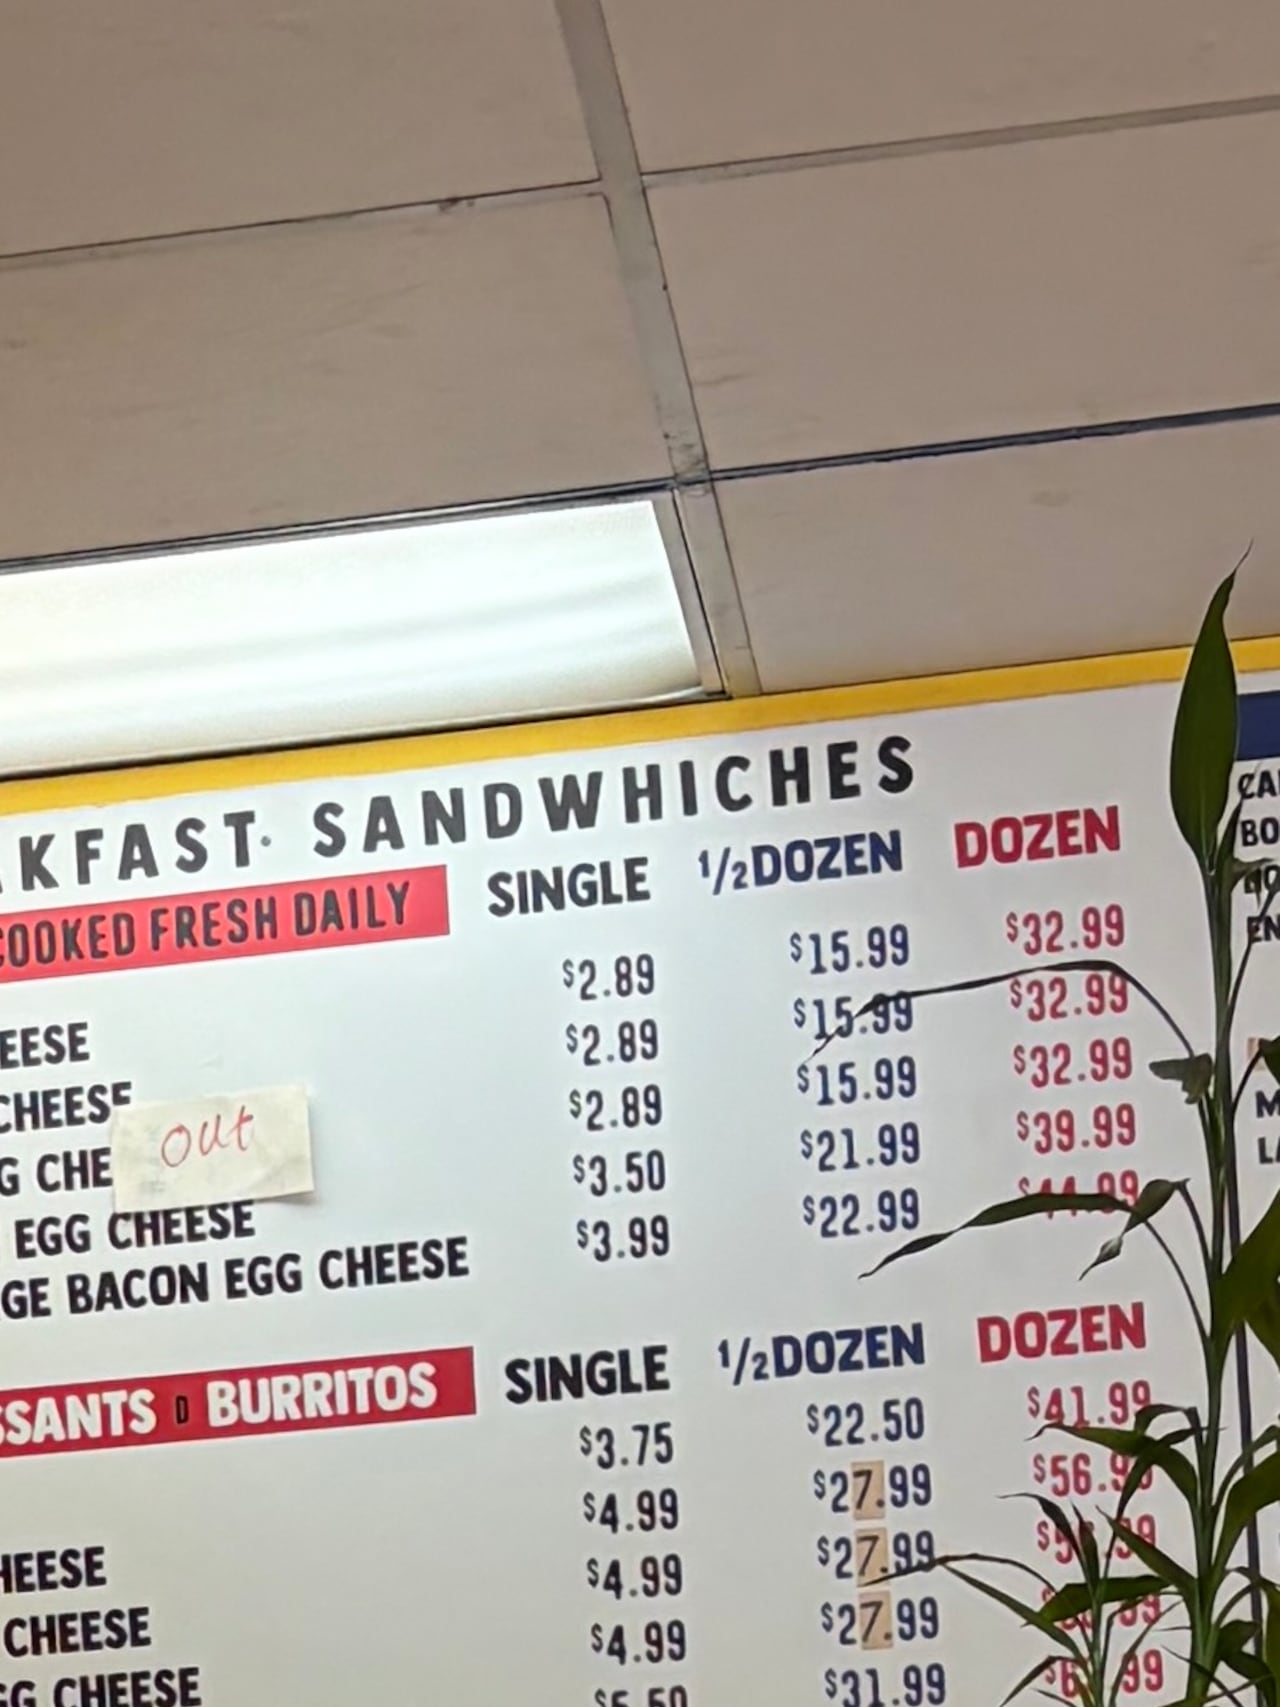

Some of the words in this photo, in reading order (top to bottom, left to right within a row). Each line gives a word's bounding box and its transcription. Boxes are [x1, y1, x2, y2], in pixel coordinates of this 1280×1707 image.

[314, 735, 913, 857] SANDWHICHES
[488, 857, 650, 917] SINGLE
[955, 805, 1120, 868] DOZEN
[150, 896, 278, 952] FRESH
[295, 881, 412, 937] DAILY
[563, 954, 654, 1000] $2.89
[790, 924, 909, 974] $15.99
[1006, 904, 1124, 955] $32.99
[566, 1019, 658, 1066] $2.89
[793, 993, 914, 1044] $15.99
[1009, 970, 1129, 1022] $32.99
[570, 1084, 662, 1131] $2.89
[797, 1056, 916, 1106] $15.99
[1014, 1037, 1132, 1088] $32.99
[573, 1149, 665, 1196] $3.50
[801, 1122, 920, 1172] $21.99
[1017, 1103, 1135, 1154] $39.99
[15, 1214, 91, 1259] EGG
[108, 1201, 255, 1251] CHEESE
[577, 1215, 669, 1262] $3.99
[803, 1188, 919, 1238] $22.99
[67, 1262, 209, 1314] BACON
[225, 1253, 302, 1299] EGG
[320, 1236, 469, 1289] CHEESE
[505, 1345, 670, 1404] SINGLE
[978, 1302, 1146, 1363] DOZEN
[207, 1362, 437, 1427] BURRITOS
[580, 1422, 673, 1469] $3.75
[807, 1397, 924, 1447] $22.50
[584, 1488, 678, 1533] $4.99
[813, 1464, 932, 1513] $27.99
[587, 1554, 682, 1600] $4.99
[816, 1532, 934, 1582] $27.99
[4, 1607, 151, 1657] CHEESE
[591, 1620, 685, 1665] $4.99
[821, 1598, 940, 1646] $27.99
